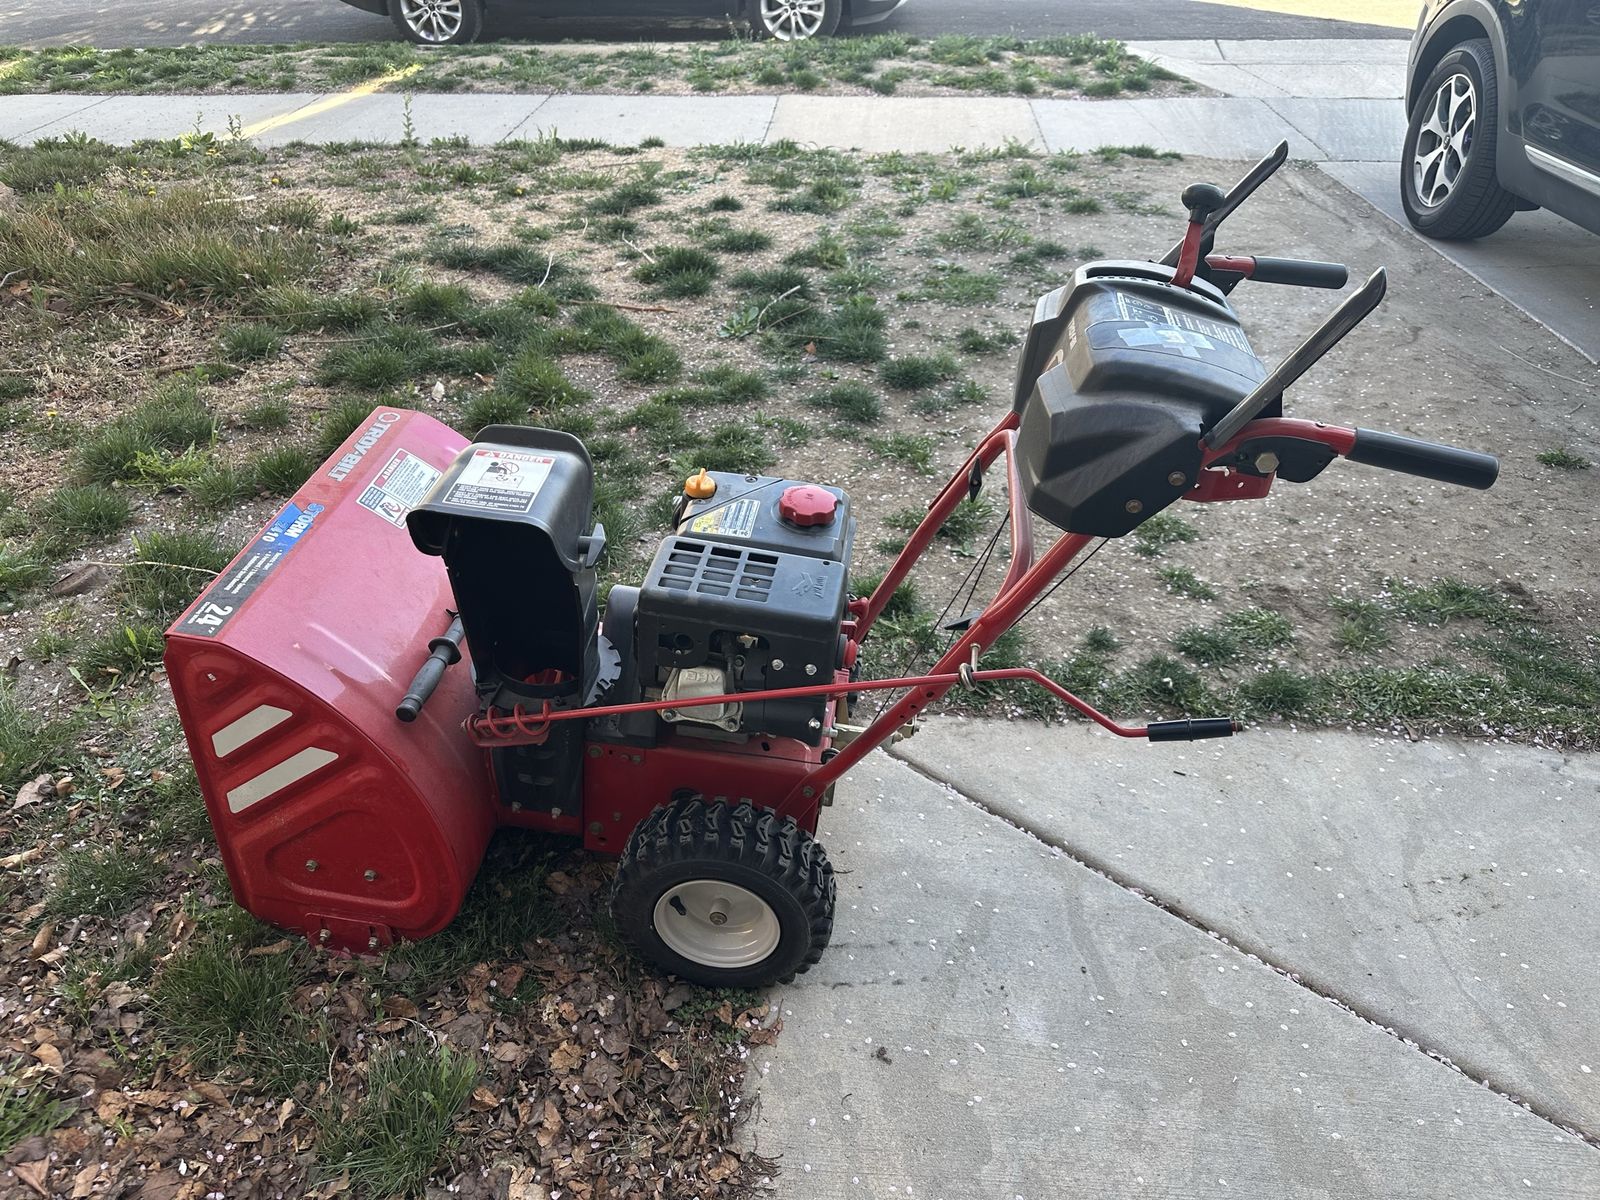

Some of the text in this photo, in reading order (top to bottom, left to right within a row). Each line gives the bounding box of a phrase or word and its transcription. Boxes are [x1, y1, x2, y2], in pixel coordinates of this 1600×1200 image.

[328, 421, 392, 482] TROY-BILT
[499, 452, 544, 463] DANGER
[262, 519, 290, 542] 2410
[284, 503, 325, 538] STORM
